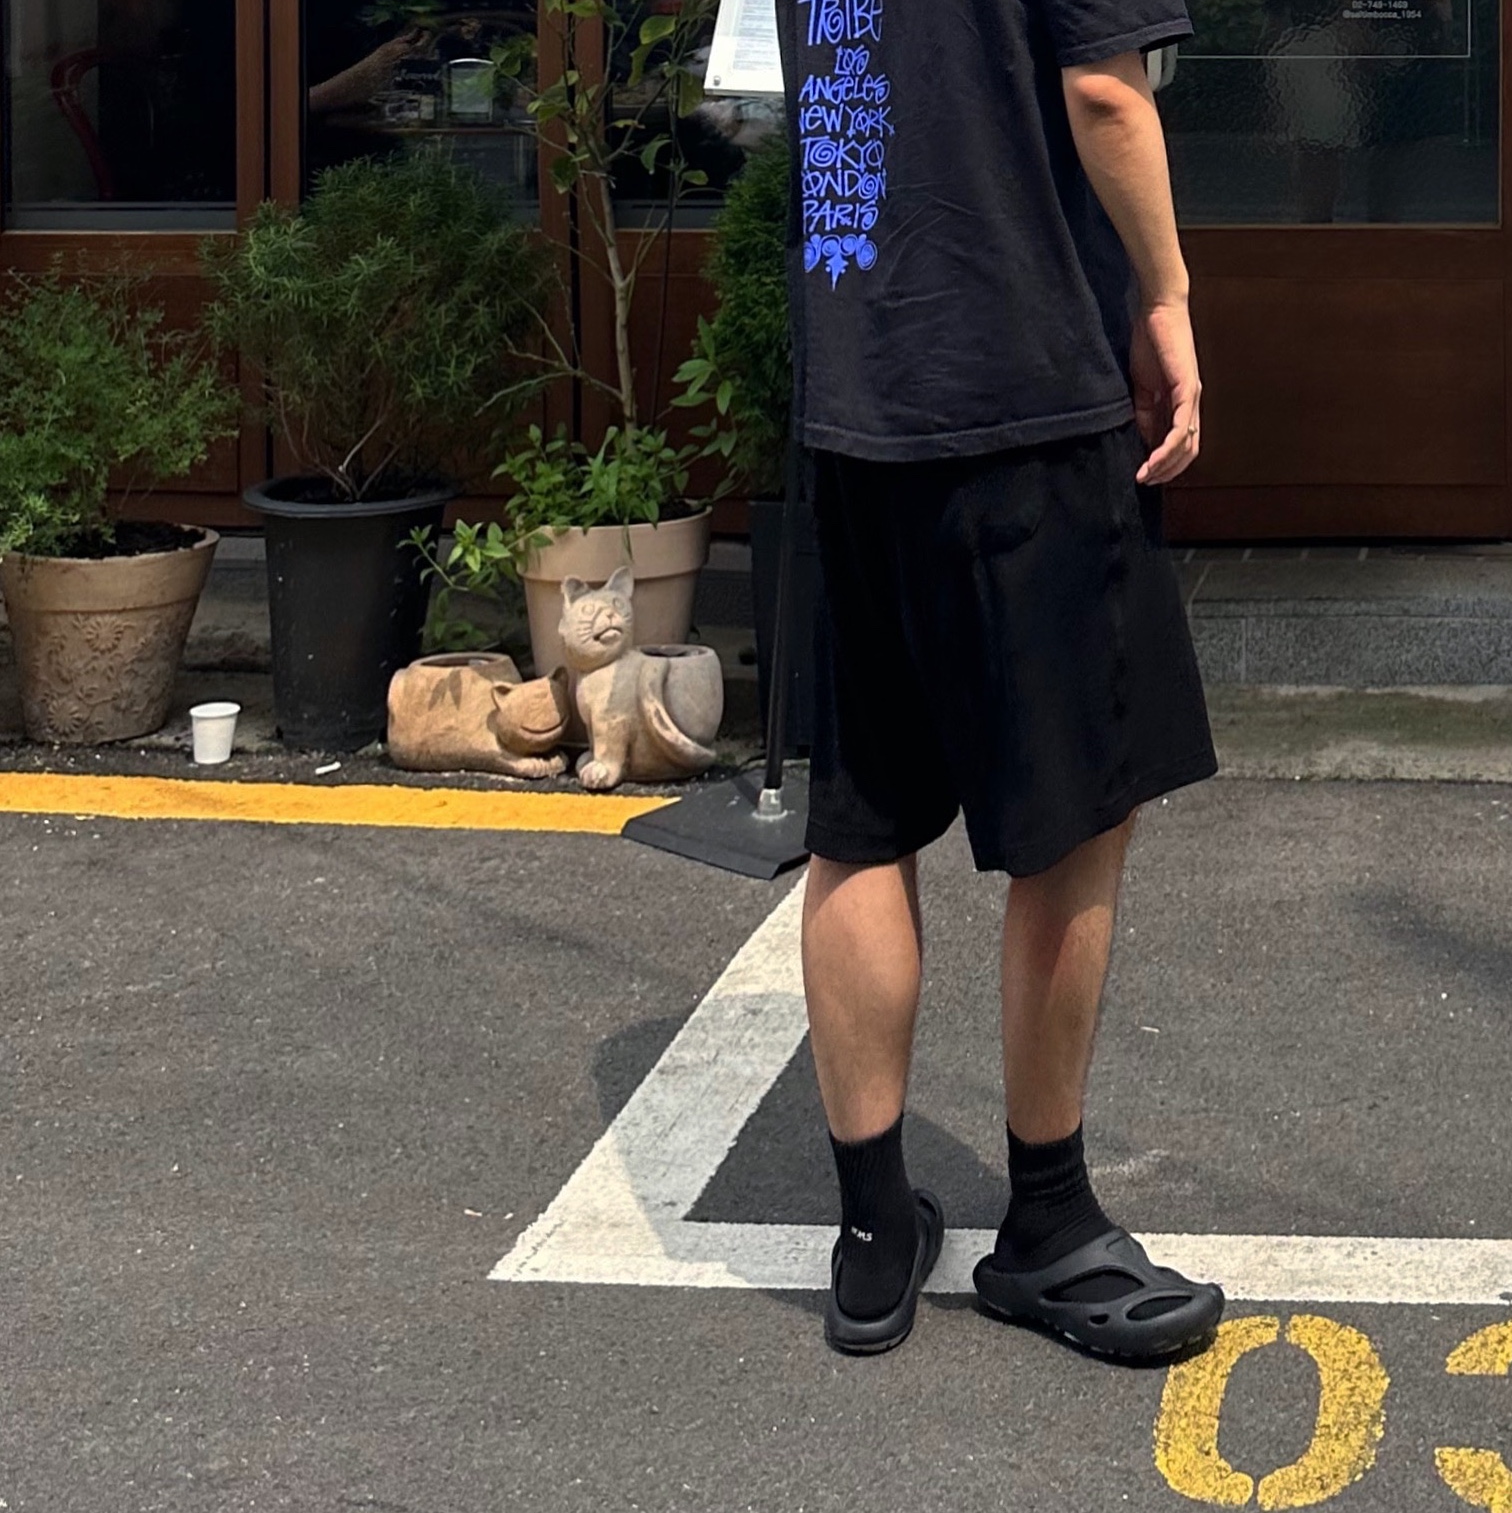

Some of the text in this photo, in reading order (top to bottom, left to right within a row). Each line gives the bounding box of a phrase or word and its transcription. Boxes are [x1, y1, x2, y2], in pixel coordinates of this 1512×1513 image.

[845, 104, 896, 139] YORK
[800, 136, 885, 173] TOKYO
[801, 168, 887, 201] ONDON
[803, 199, 878, 235] PARIS
